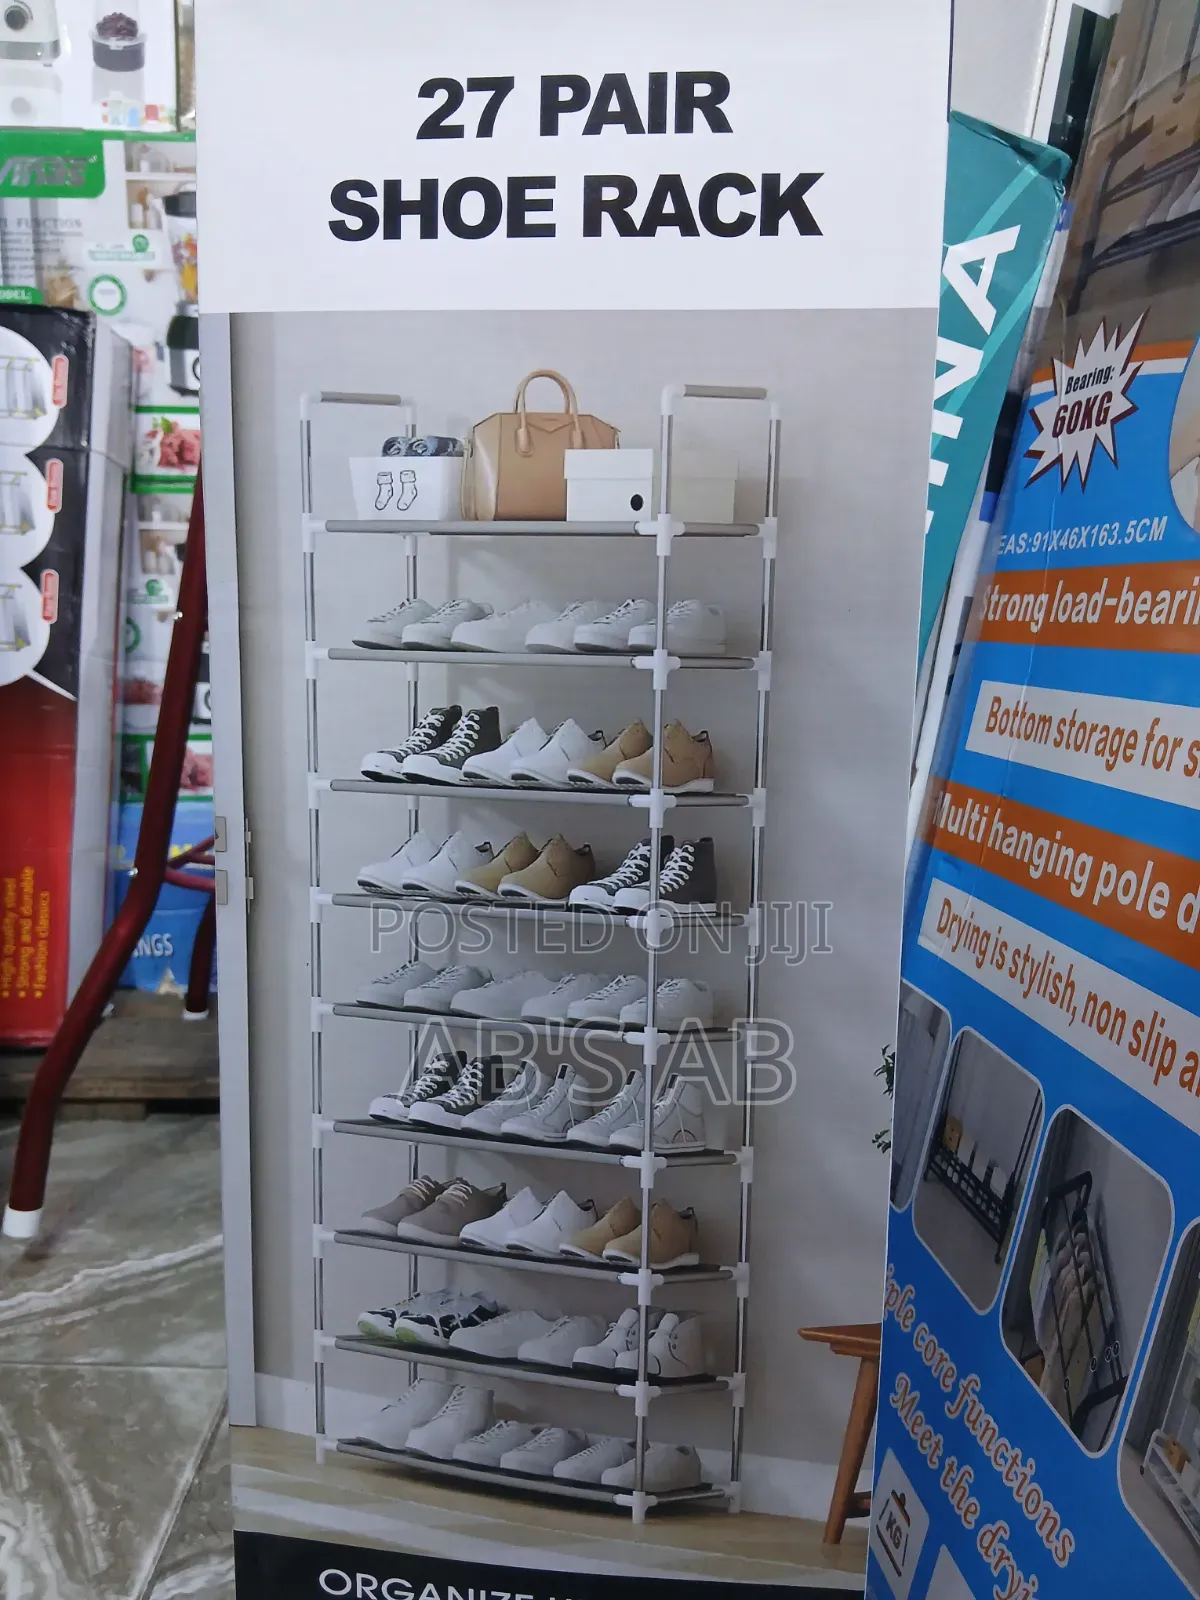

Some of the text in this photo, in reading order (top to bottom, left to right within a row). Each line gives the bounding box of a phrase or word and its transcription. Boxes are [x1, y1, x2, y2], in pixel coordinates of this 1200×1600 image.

[416, 70, 734, 140] 27 PAIR
[328, 172, 825, 242] SHOE RACK
[1052, 391, 1114, 438] 60KG
[1065, 364, 1115, 395] Bearing:
[998, 515, 1168, 555] EAS:91X46X163.5CM
[985, 695, 1053, 746] Bottom
[1053, 708, 1138, 772] storage
[1141, 717, 1184, 772] for
[987, 807, 1094, 898] hanging
[1092, 860, 1170, 920] pole
[132, 933, 174, 957] NGS
[936, 896, 992, 969] Drying
[990, 926, 1006, 971] is
[1008, 943, 1079, 1027] stylish,
[1081, 990, 1127, 1046] non
[1128, 1009, 1178, 1086] slip
[890, 1373, 944, 1469] Meet
[941, 1456, 980, 1529] the
[913, 1323, 957, 1391] core
[945, 1374, 1076, 1568] functions
[886, 1511, 903, 1550] KG
